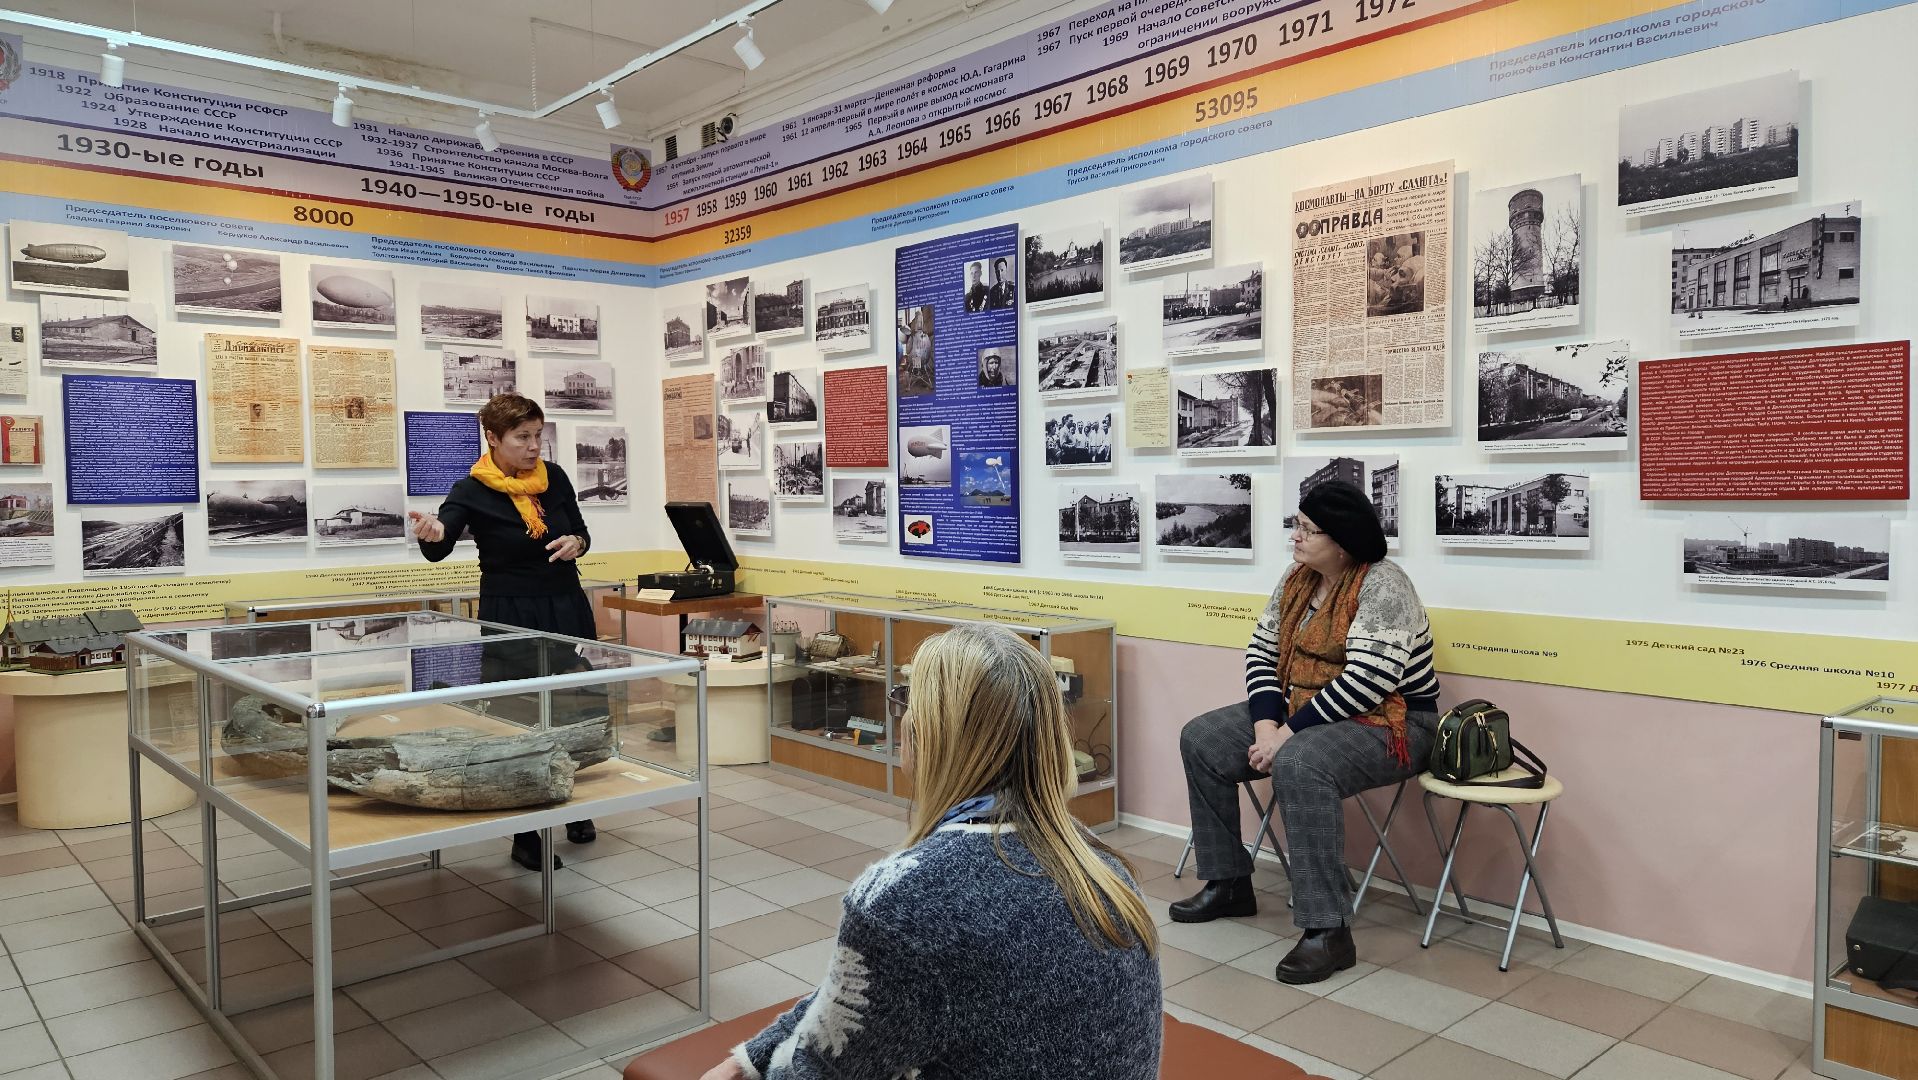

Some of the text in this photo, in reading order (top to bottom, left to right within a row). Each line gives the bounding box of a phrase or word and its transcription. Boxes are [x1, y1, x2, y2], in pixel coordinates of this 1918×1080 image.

[1037, 2, 1131, 42] 1967 Переход на
[1037, 40, 1060, 56] 1967
[1069, 30, 1094, 44] Пуск
[1096, 12, 1136, 34] первой
[1102, 31, 1128, 46] 1969
[1138, 13, 1182, 34] Начало
[1138, 16, 1218, 48] ограничении
[1490, 42, 1584, 70] Председатель
[1589, 19, 1670, 45] исполкома
[1490, 20, 1718, 82] Прокофьев Константин Васильевич
[30, 67, 65, 80] 1918
[153, 87, 241, 110] Конституции
[246, 103, 288, 117] РСФСР
[57, 84, 236, 120] 1922 Образование СССР
[782, 132, 797, 142] 1961
[802, 128, 808, 136] 12
[811, 108, 866, 135] апреля-первый
[874, 100, 894, 113] мире
[897, 90, 918, 104] полёт
[928, 78, 958, 94] космос
[960, 70, 982, 82] Ю.А.
[984, 54, 1026, 74] Гагарина
[782, 122, 796, 132] 1961
[918, 66, 956, 86] реформа
[845, 122, 862, 133] 1965
[868, 108, 898, 126] Первый
[906, 101, 928, 115] мире
[930, 91, 958, 106] выход
[960, 72, 1014, 95] космонавта
[1196, 87, 1258, 122] 53095
[81, 101, 342, 148] 1924 Утверждение Конституции СССР
[664, 208, 690, 225] 1957
[696, 199, 718, 217] 1958
[724, 191, 746, 210] 1959
[754, 182, 778, 200] 1960
[788, 172, 812, 192] 1961
[822, 161, 849, 182] 1962
[858, 150, 886, 172] 1963
[898, 137, 928, 160] 1964
[939, 124, 972, 148] 1965
[986, 108, 1020, 134] 1966
[1034, 92, 1072, 120] 1967
[1086, 75, 1128, 104] 1968
[1144, 55, 1190, 86] 1969
[1207, 34, 1258, 68] 1970
[1279, 10, 1334, 46] 1971
[868, 128, 884, 138] А.А.
[886, 116, 920, 132] Леонова
[928, 99, 971, 118] открытый
[974, 87, 1006, 104] космос
[57, 133, 264, 178] 1930-ые годы
[113, 118, 336, 158] 1928 Начало индустриализации
[353, 122, 379, 133] 1931
[388, 128, 429, 141] Начало
[431, 136, 540, 160] дирижабстроения
[550, 155, 574, 165] СССР
[675, 158, 696, 168] октября
[701, 150, 720, 160] запуск
[720, 142, 744, 153] первого
[750, 133, 766, 143] мире
[1068, 120, 1273, 177] Председатель исполкома городского совета
[361, 134, 609, 180] 1932-1937 Строительство канала Москва-Волга
[377, 147, 560, 182] 1936 Принятие Конституции СССР
[672, 162, 714, 180] спутника Земли
[682, 152, 770, 186] Запуск первой автоматической
[1067, 157, 1166, 186] Трусов Василий Григорьевич
[390, 160, 604, 198] 1941-1945 Великая Отечественная война
[683, 161, 778, 195] межпланетной станции «Луна-1»
[1368, 182, 1394, 197] БОРТУ
[1398, 172, 1448, 190] «САЛЮТА»!
[66, 204, 254, 231] Председатель поселкового совета
[294, 206, 354, 226] 8000
[360, 177, 594, 223] 1940—1950-ые годы
[872, 185, 1014, 224] Председатель исполкома городского совета
[66, 214, 191, 232] Гладков Гавриил Захарович
[724, 224, 752, 244] 32359
[1320, 208, 1382, 234] ПРАВДА
[260, 234, 302, 244] Александр
[372, 236, 432, 249] Председатель
[434, 244, 487, 255] поселкового
[1472, 644, 1509, 654] Средняя
[1542, 650, 1558, 658] №9
[1626, 639, 1745, 656] 1975 Детский сад №23
[1740, 658, 1895, 679] 1976 Средняя школа №10
[1877, 682, 1905, 691] 1977
